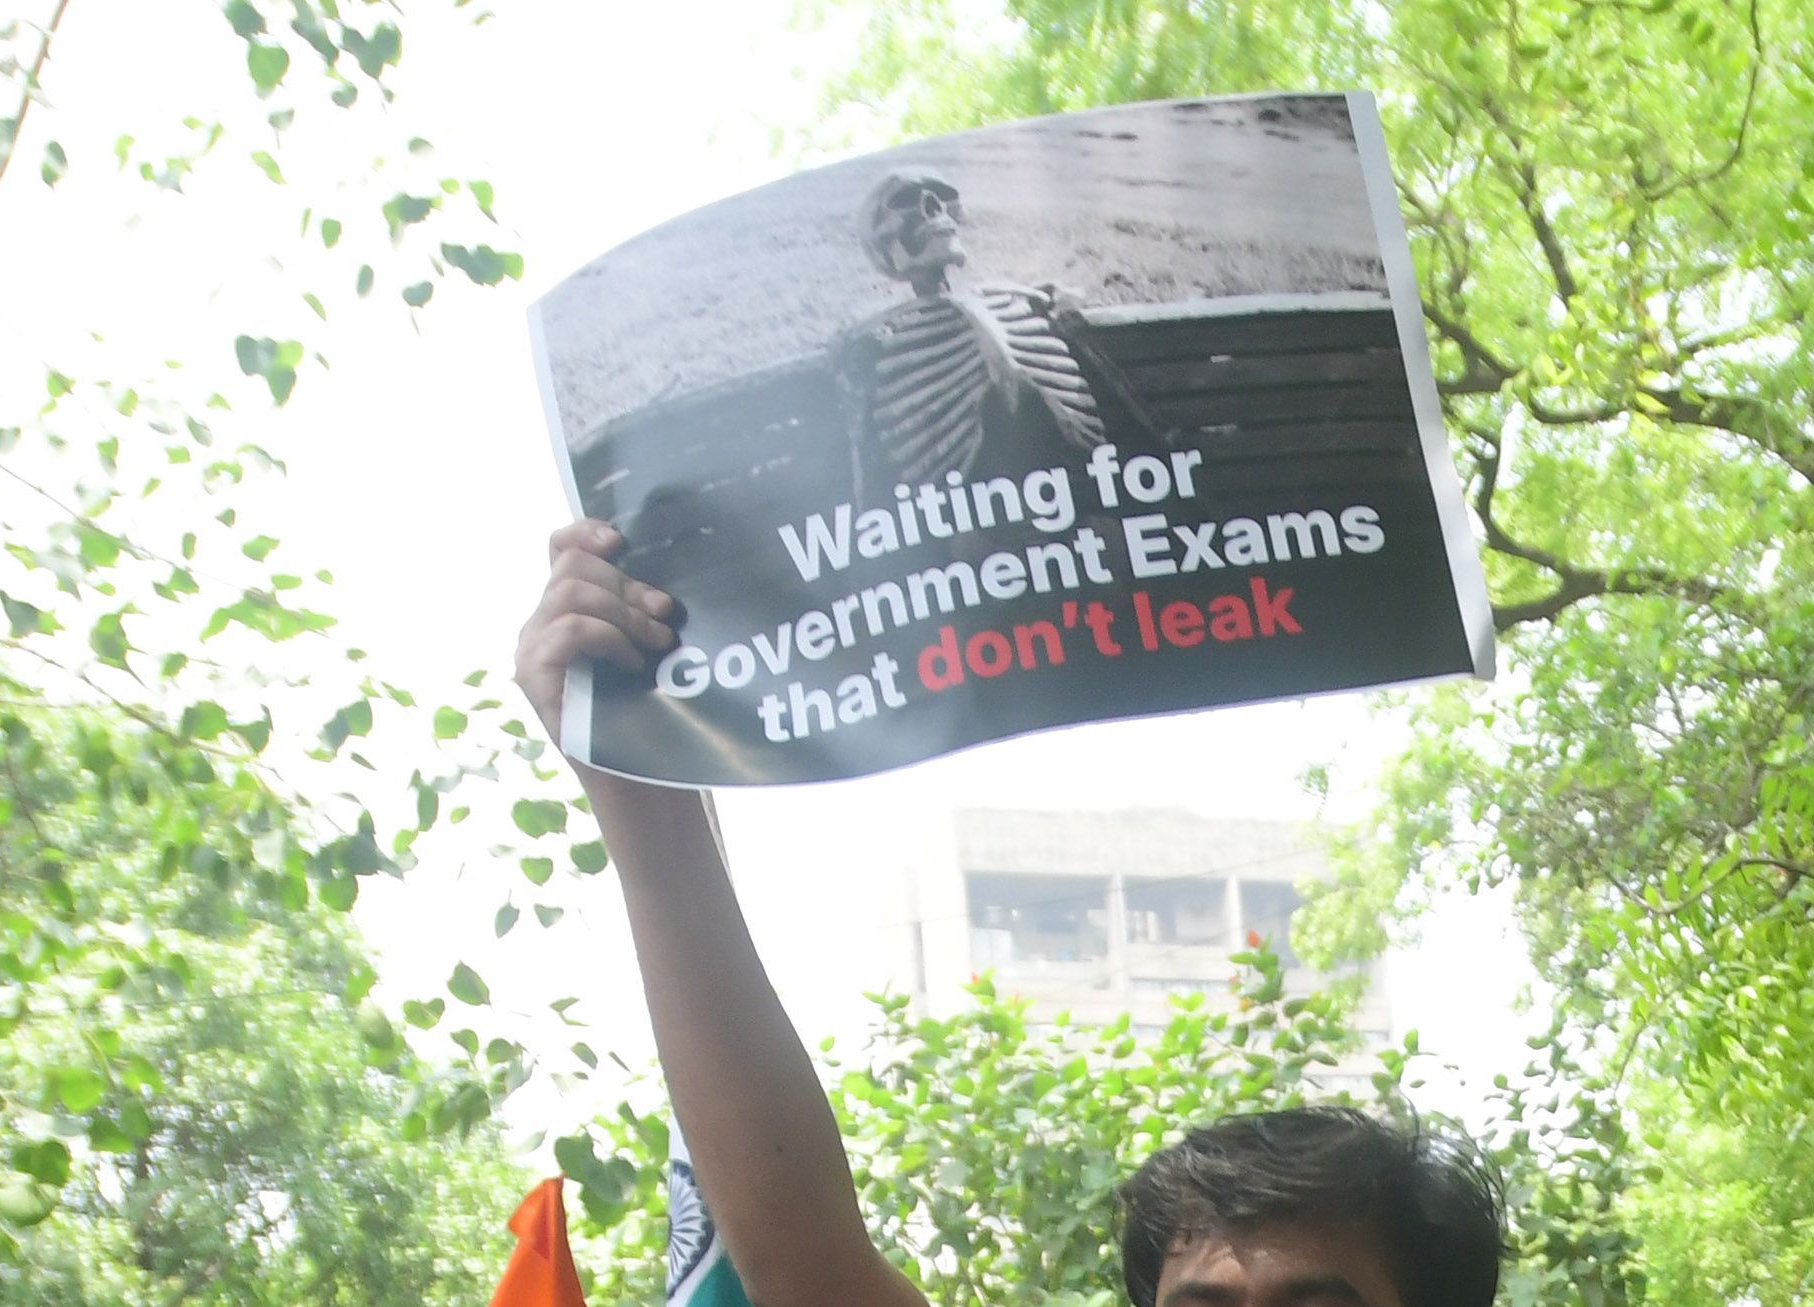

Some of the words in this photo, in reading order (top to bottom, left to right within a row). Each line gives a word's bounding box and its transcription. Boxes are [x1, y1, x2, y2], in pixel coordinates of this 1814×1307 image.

[777, 469, 1077, 583] Waiting
[1086, 442, 1203, 508] for
[655, 525, 1115, 699] Government
[1121, 503, 1386, 580] Exams
[756, 651, 908, 743] that
[916, 600, 1123, 694] don't
[1131, 575, 1305, 652] leak
